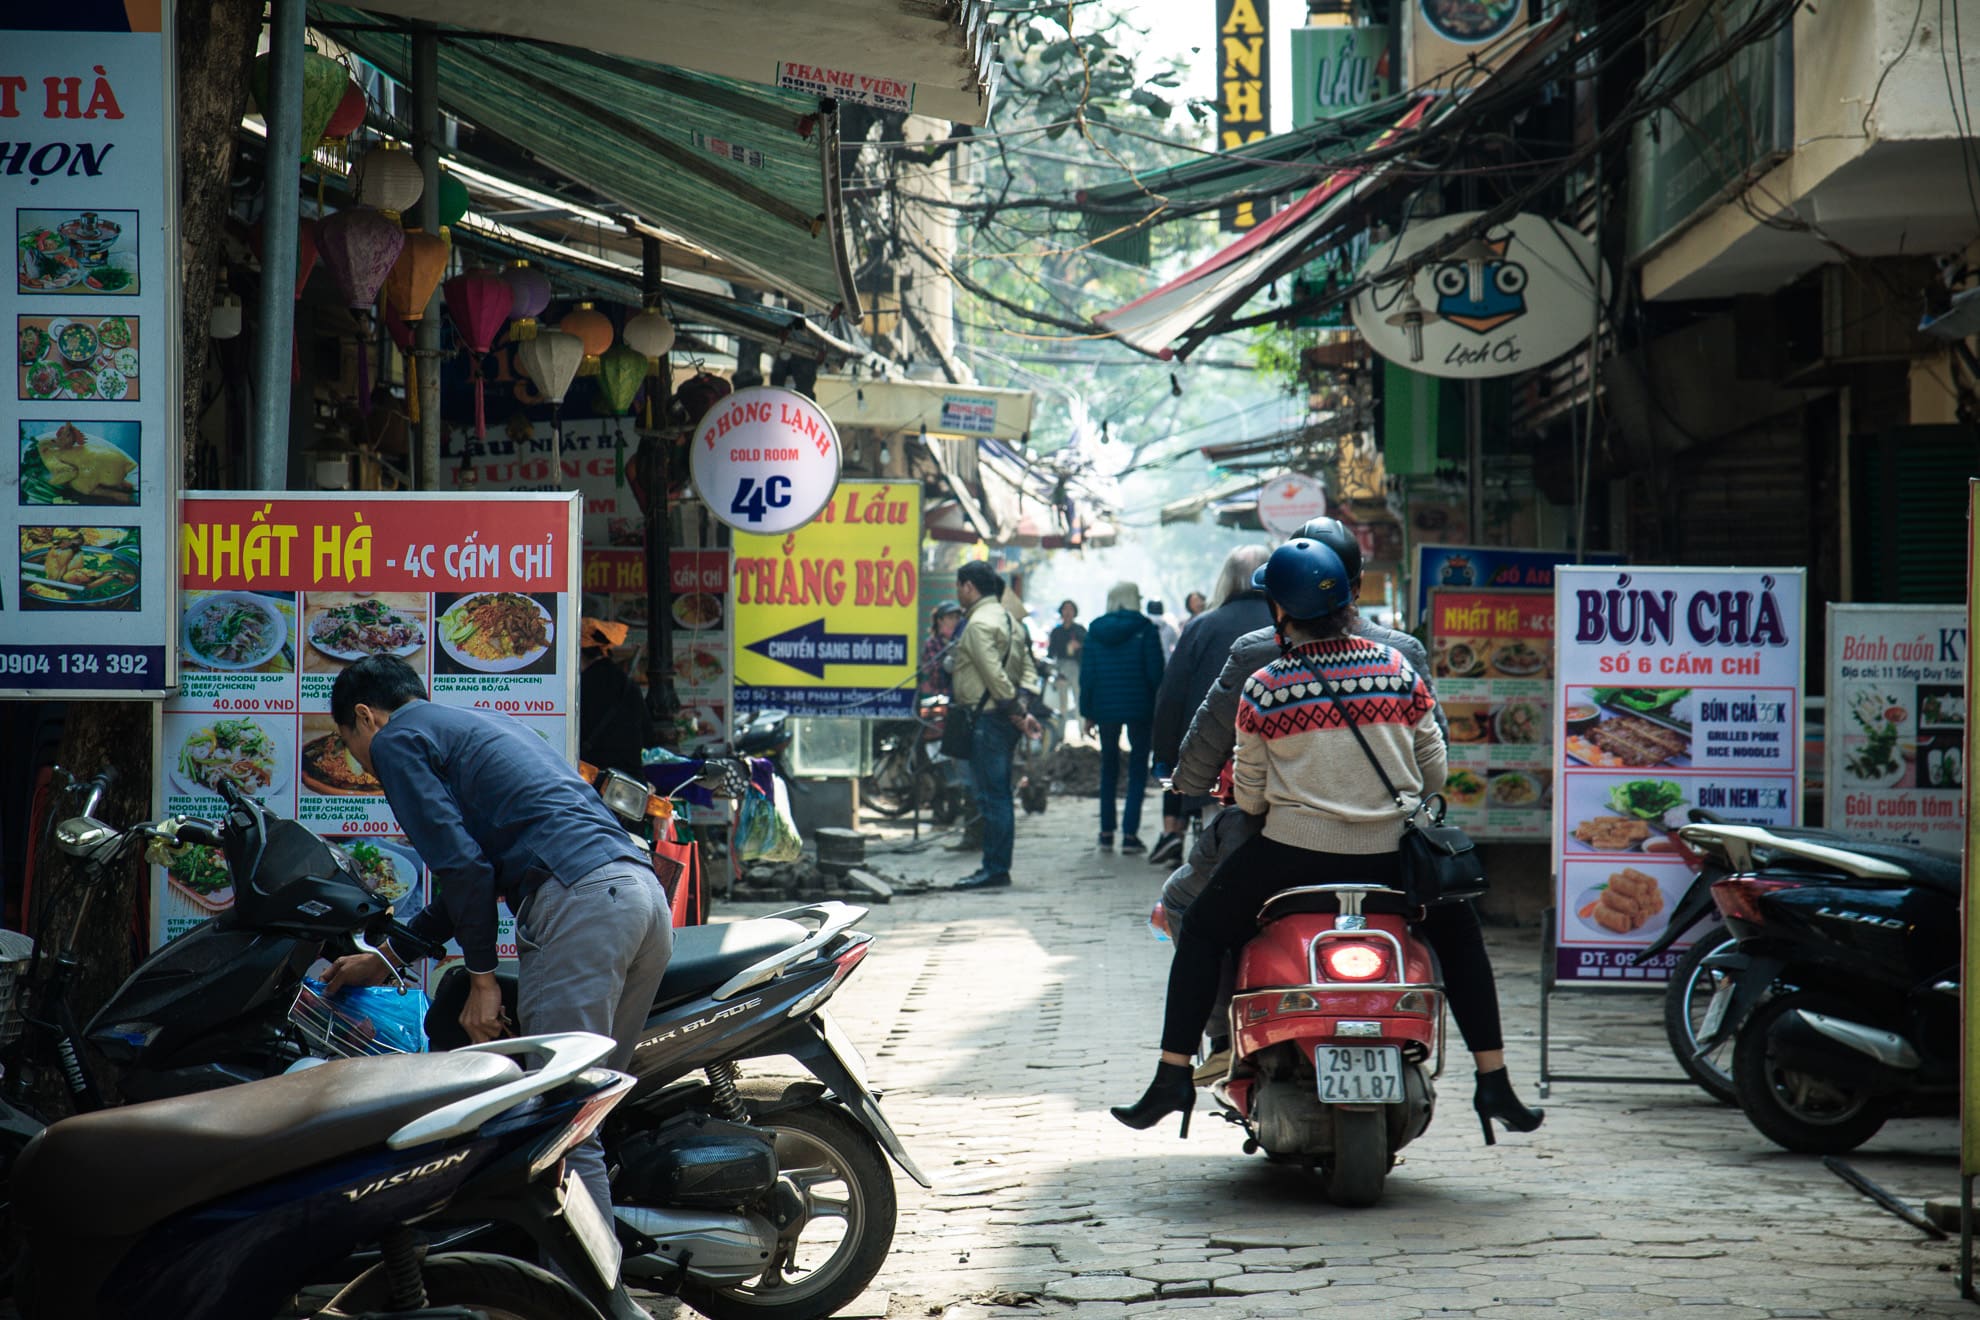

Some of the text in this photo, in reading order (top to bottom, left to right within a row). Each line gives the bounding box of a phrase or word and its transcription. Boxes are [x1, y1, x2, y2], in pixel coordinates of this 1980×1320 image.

[785, 62, 855, 88] THANH
[43, 64, 125, 120] HÀ
[704, 400, 831, 457] PHÒNG LẠNH
[730, 448, 799, 462] COLD ROOM
[731, 475, 791, 522] 4C
[845, 486, 909, 525] Lẩu
[184, 503, 299, 583] NHẤT
[313, 511, 373, 584] HÀ
[403, 544, 436, 578] 4C
[444, 530, 500, 582] CẤM
[509, 532, 553, 583] CHỈ
[854, 546, 916, 607] BÉO
[1444, 600, 1490, 633] NHẤT
[1575, 572, 1789, 648] BÚN CHẢ
[817, 641, 849, 660] SANG
[875, 640, 904, 664] DIỆN
[1842, 634, 1888, 661] Bánh
[1892, 633, 1935, 661] cuốn
[58, 653, 99, 674] 134
[106, 654, 148, 675] 392
[1600, 651, 1761, 675] SỐ 6 CẤM CHỈ
[191, 682, 256, 690] (BEEF/CHICKEN)
[213, 699, 294, 710] 40.000 VND
[524, 700, 554, 711] VND
[1700, 697, 1728, 722] BÚN
[1732, 694, 1758, 722] CHẢ
[1707, 731, 1780, 742] GRILLED PORK
[1706, 746, 1780, 758] RICE NOODLES
[1699, 784, 1726, 808] BÚN
[1729, 788, 1759, 808] NEM
[1877, 792, 1918, 817] cuốn
[342, 822, 389, 832] 60.000
[1887, 820, 1929, 832] spring
[634, 997, 763, 1051] AIR BLADE
[57, 1036, 88, 1095] YAMAHA
[1328, 1048, 1388, 1072] 29-D1
[342, 1149, 471, 1203] VISION
